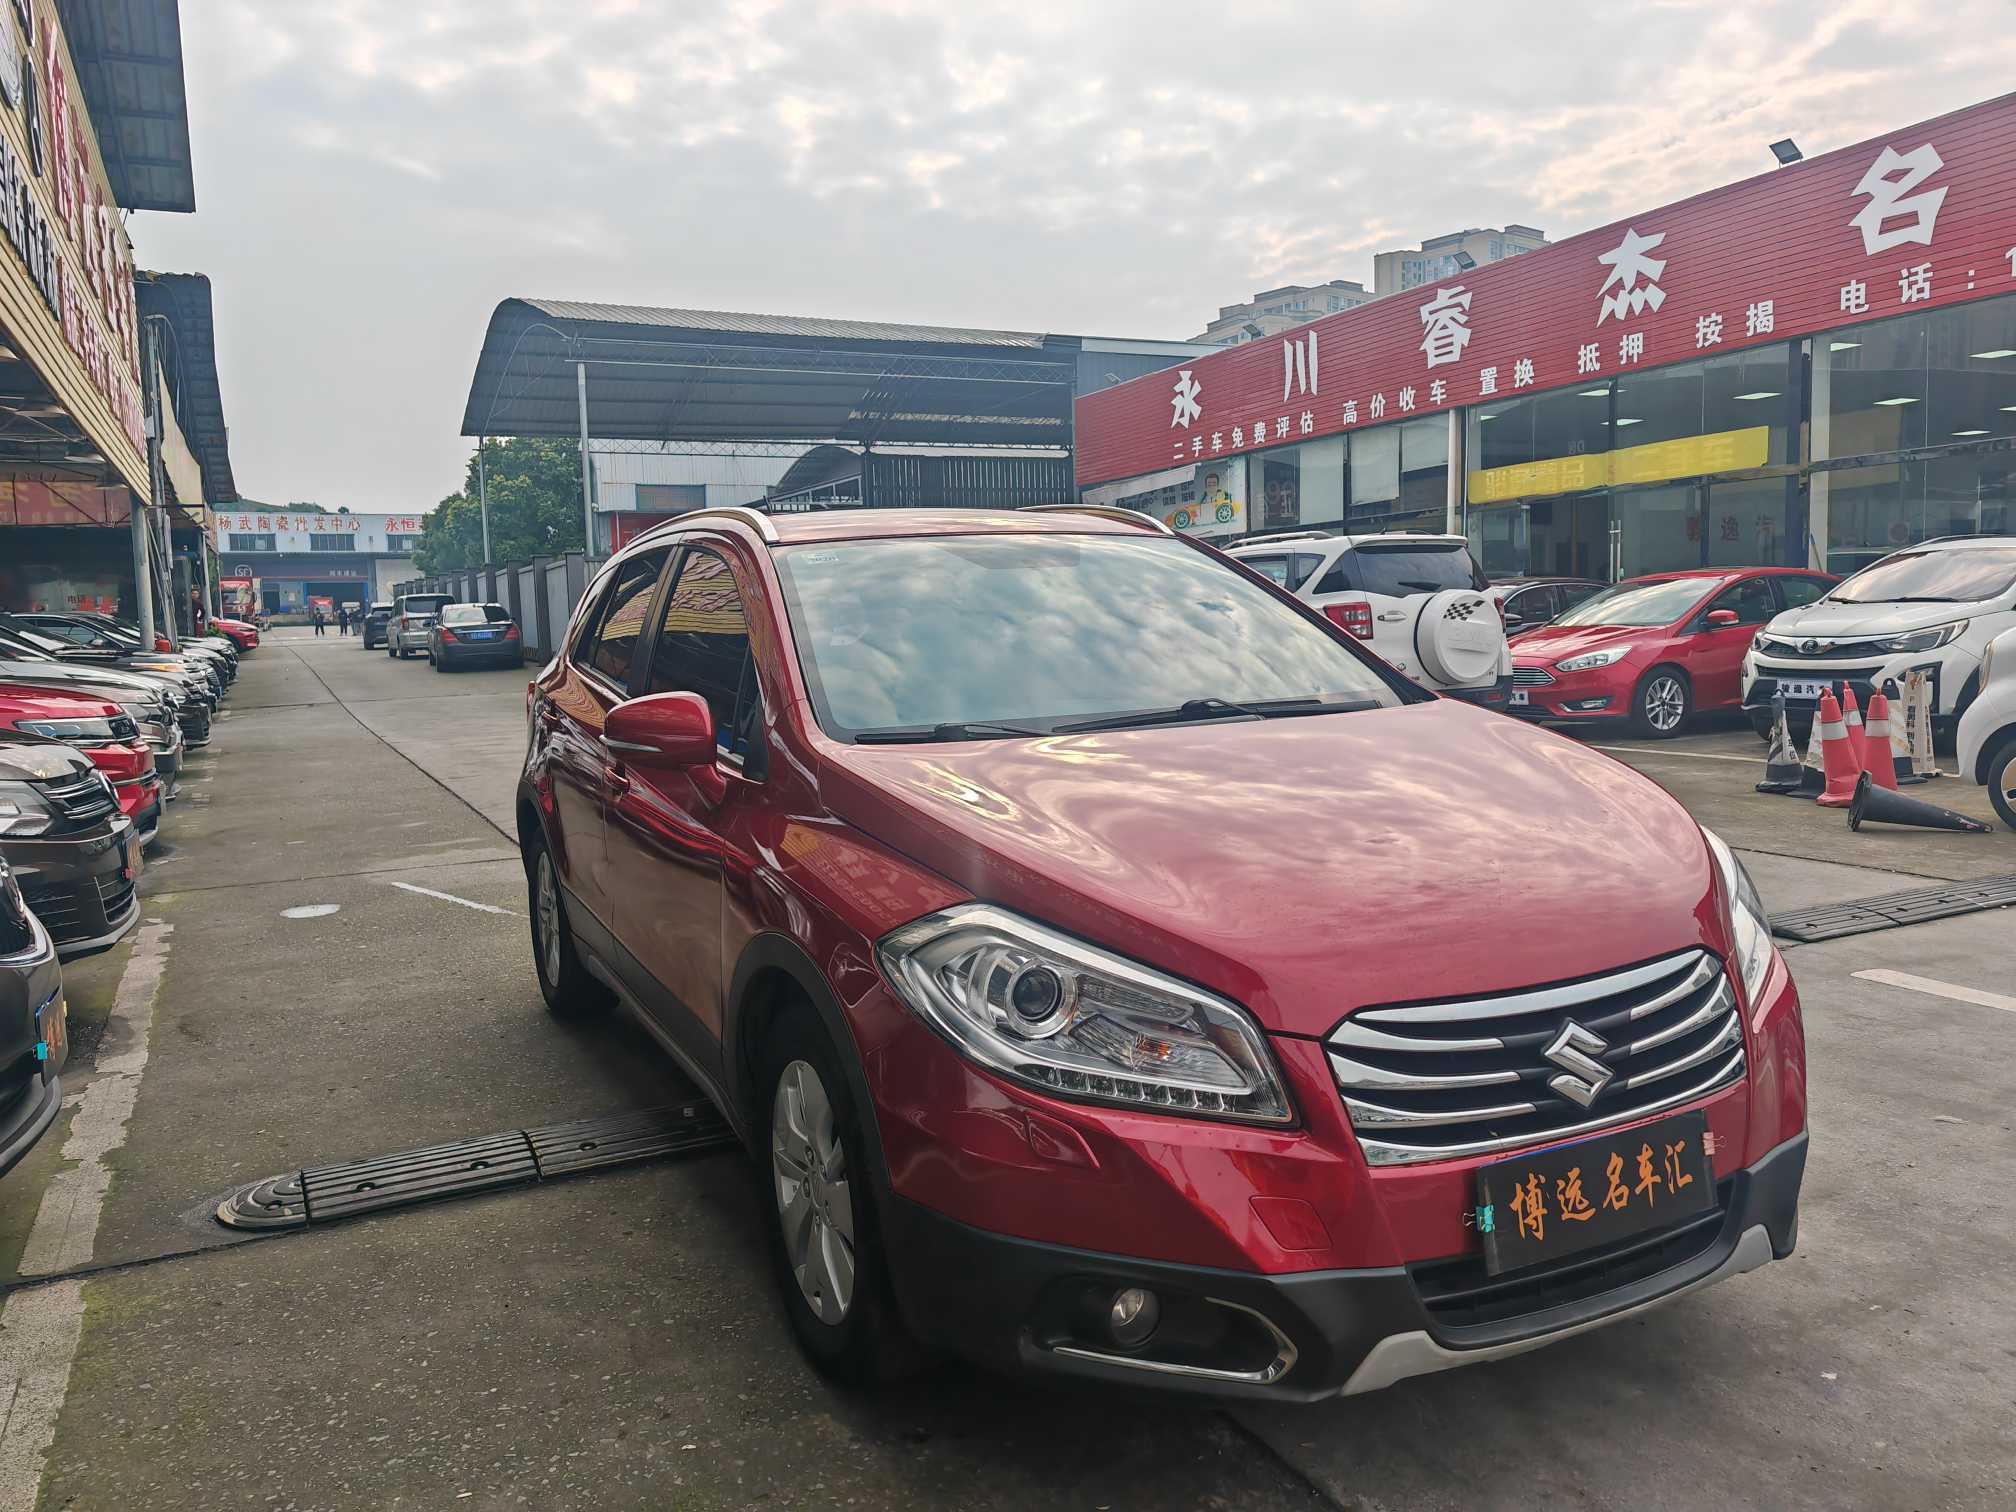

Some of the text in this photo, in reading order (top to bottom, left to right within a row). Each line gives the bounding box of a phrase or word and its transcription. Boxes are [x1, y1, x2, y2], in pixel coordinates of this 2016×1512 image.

[1173, 412, 1314, 460] 二手车免费评估
[1344, 379, 1447, 425] 高价收车
[1479, 360, 1535, 395] 置换
[1578, 332, 1645, 375] 抵押
[1695, 300, 1775, 349] 按揭
[1510, 1140, 1693, 1241] 博远名车汇
